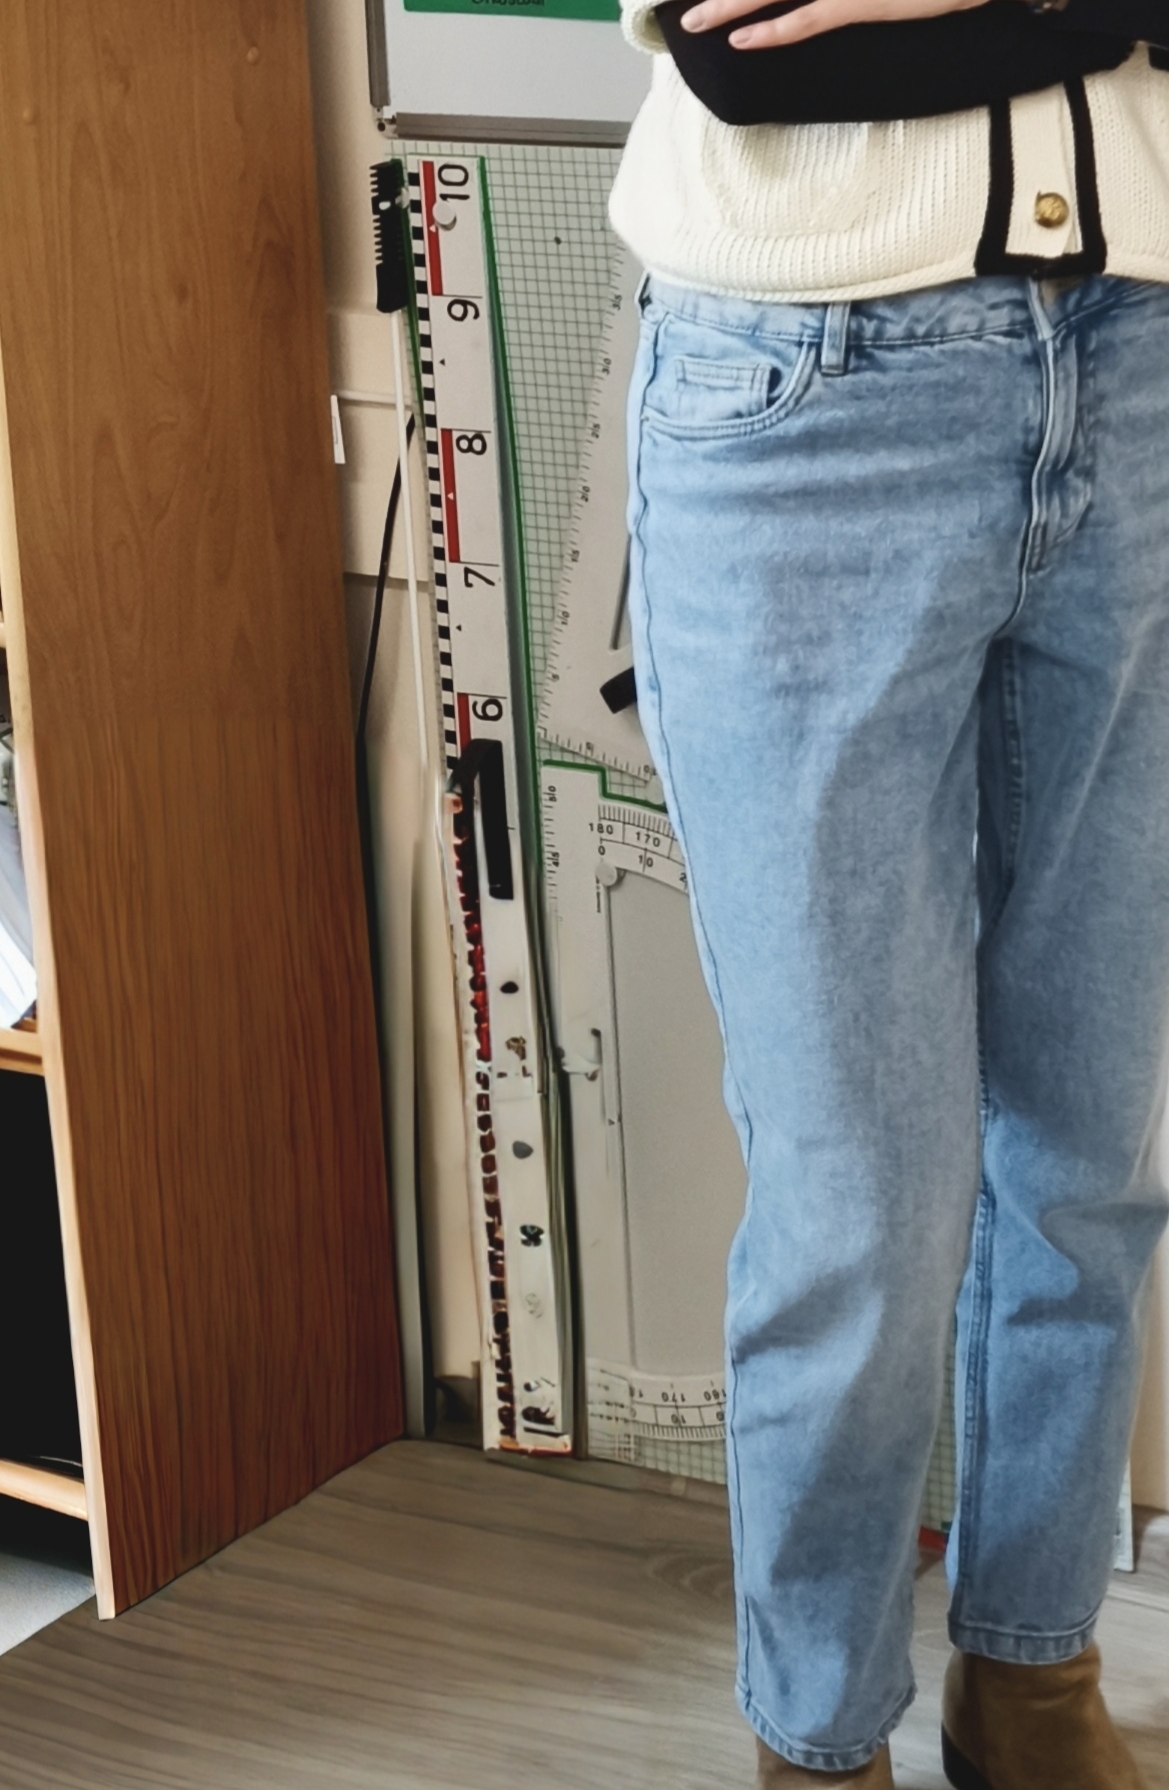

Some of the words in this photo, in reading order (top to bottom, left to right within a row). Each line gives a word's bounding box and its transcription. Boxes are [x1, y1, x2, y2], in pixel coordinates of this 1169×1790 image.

[439, 163, 471, 202] 10
[447, 298, 480, 322] 9
[455, 432, 488, 456] 8
[463, 566, 496, 589] 7
[471, 697, 504, 723] 6
[588, 822, 614, 835] 180
[635, 831, 661, 848] 170
[598, 845, 606, 856] 0
[638, 854, 654, 867] 10
